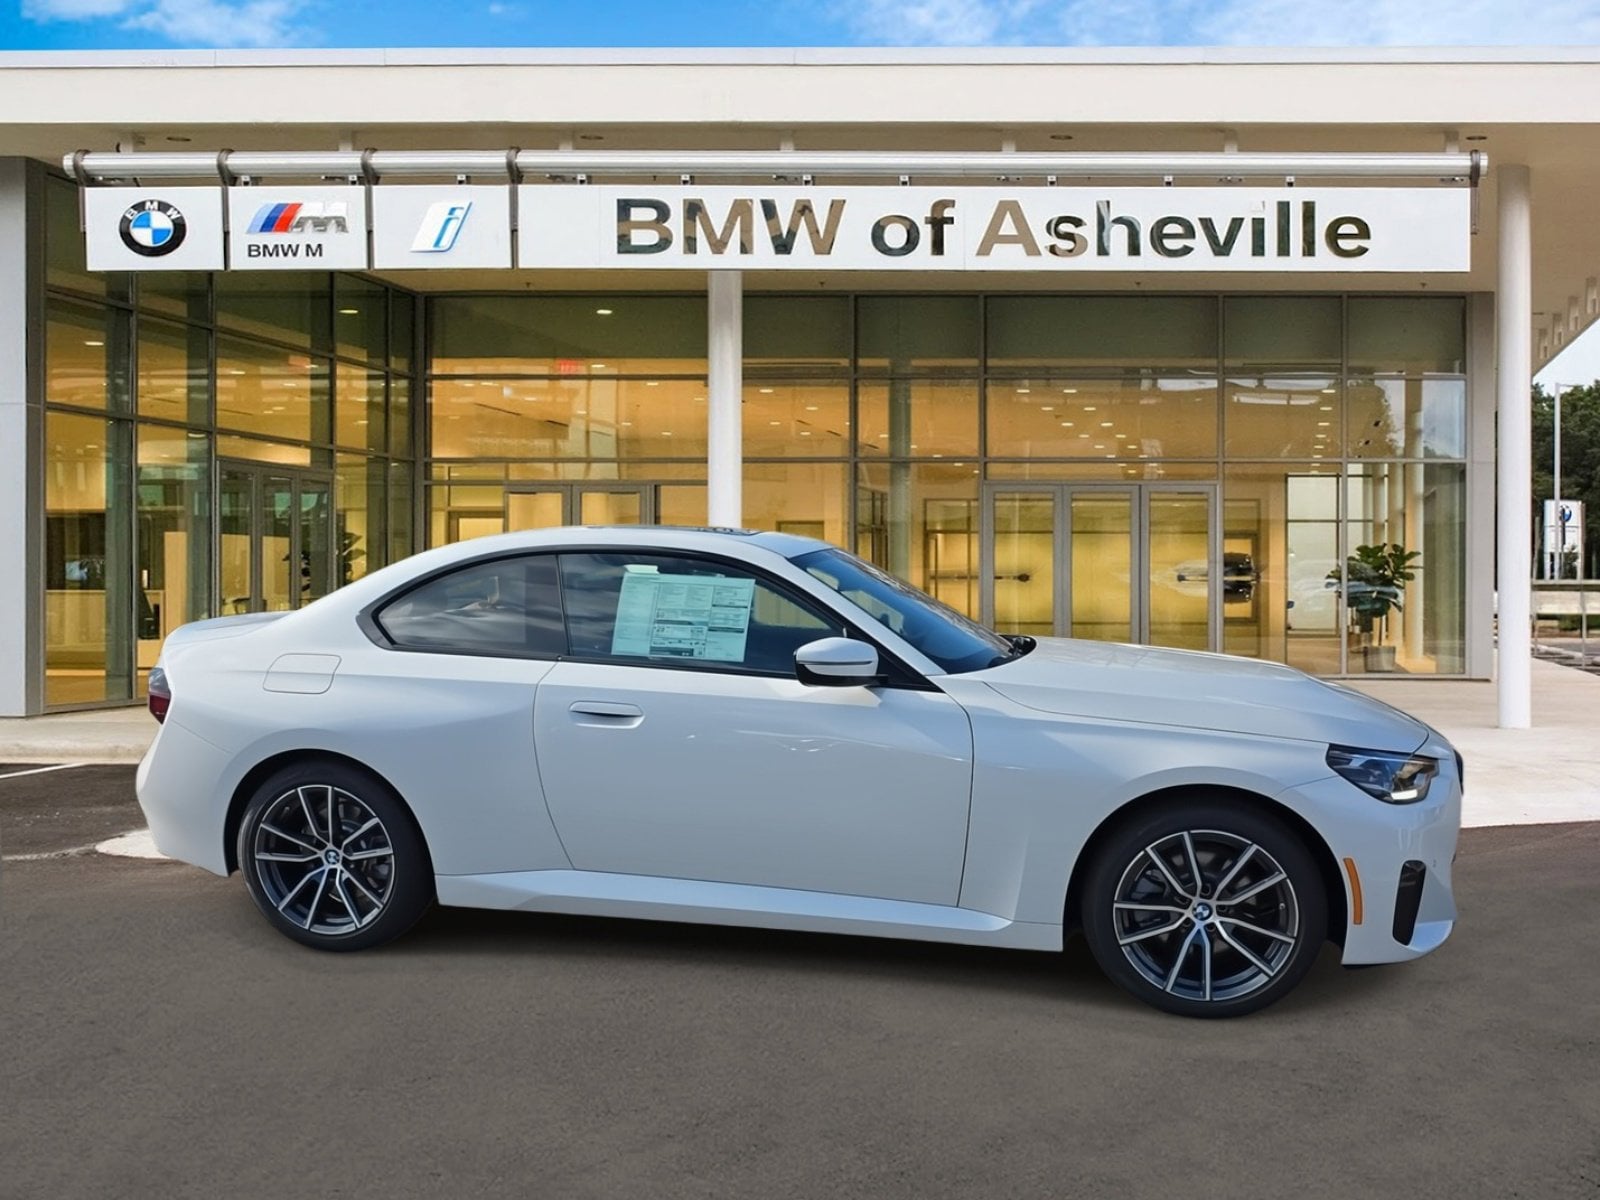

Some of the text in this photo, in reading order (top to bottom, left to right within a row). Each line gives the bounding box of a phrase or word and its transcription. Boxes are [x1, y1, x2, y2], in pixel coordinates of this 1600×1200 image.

[125, 201, 181, 220] BMW
[616, 199, 1372, 258] BMW of Asheville
[247, 244, 323, 257] BMW M
